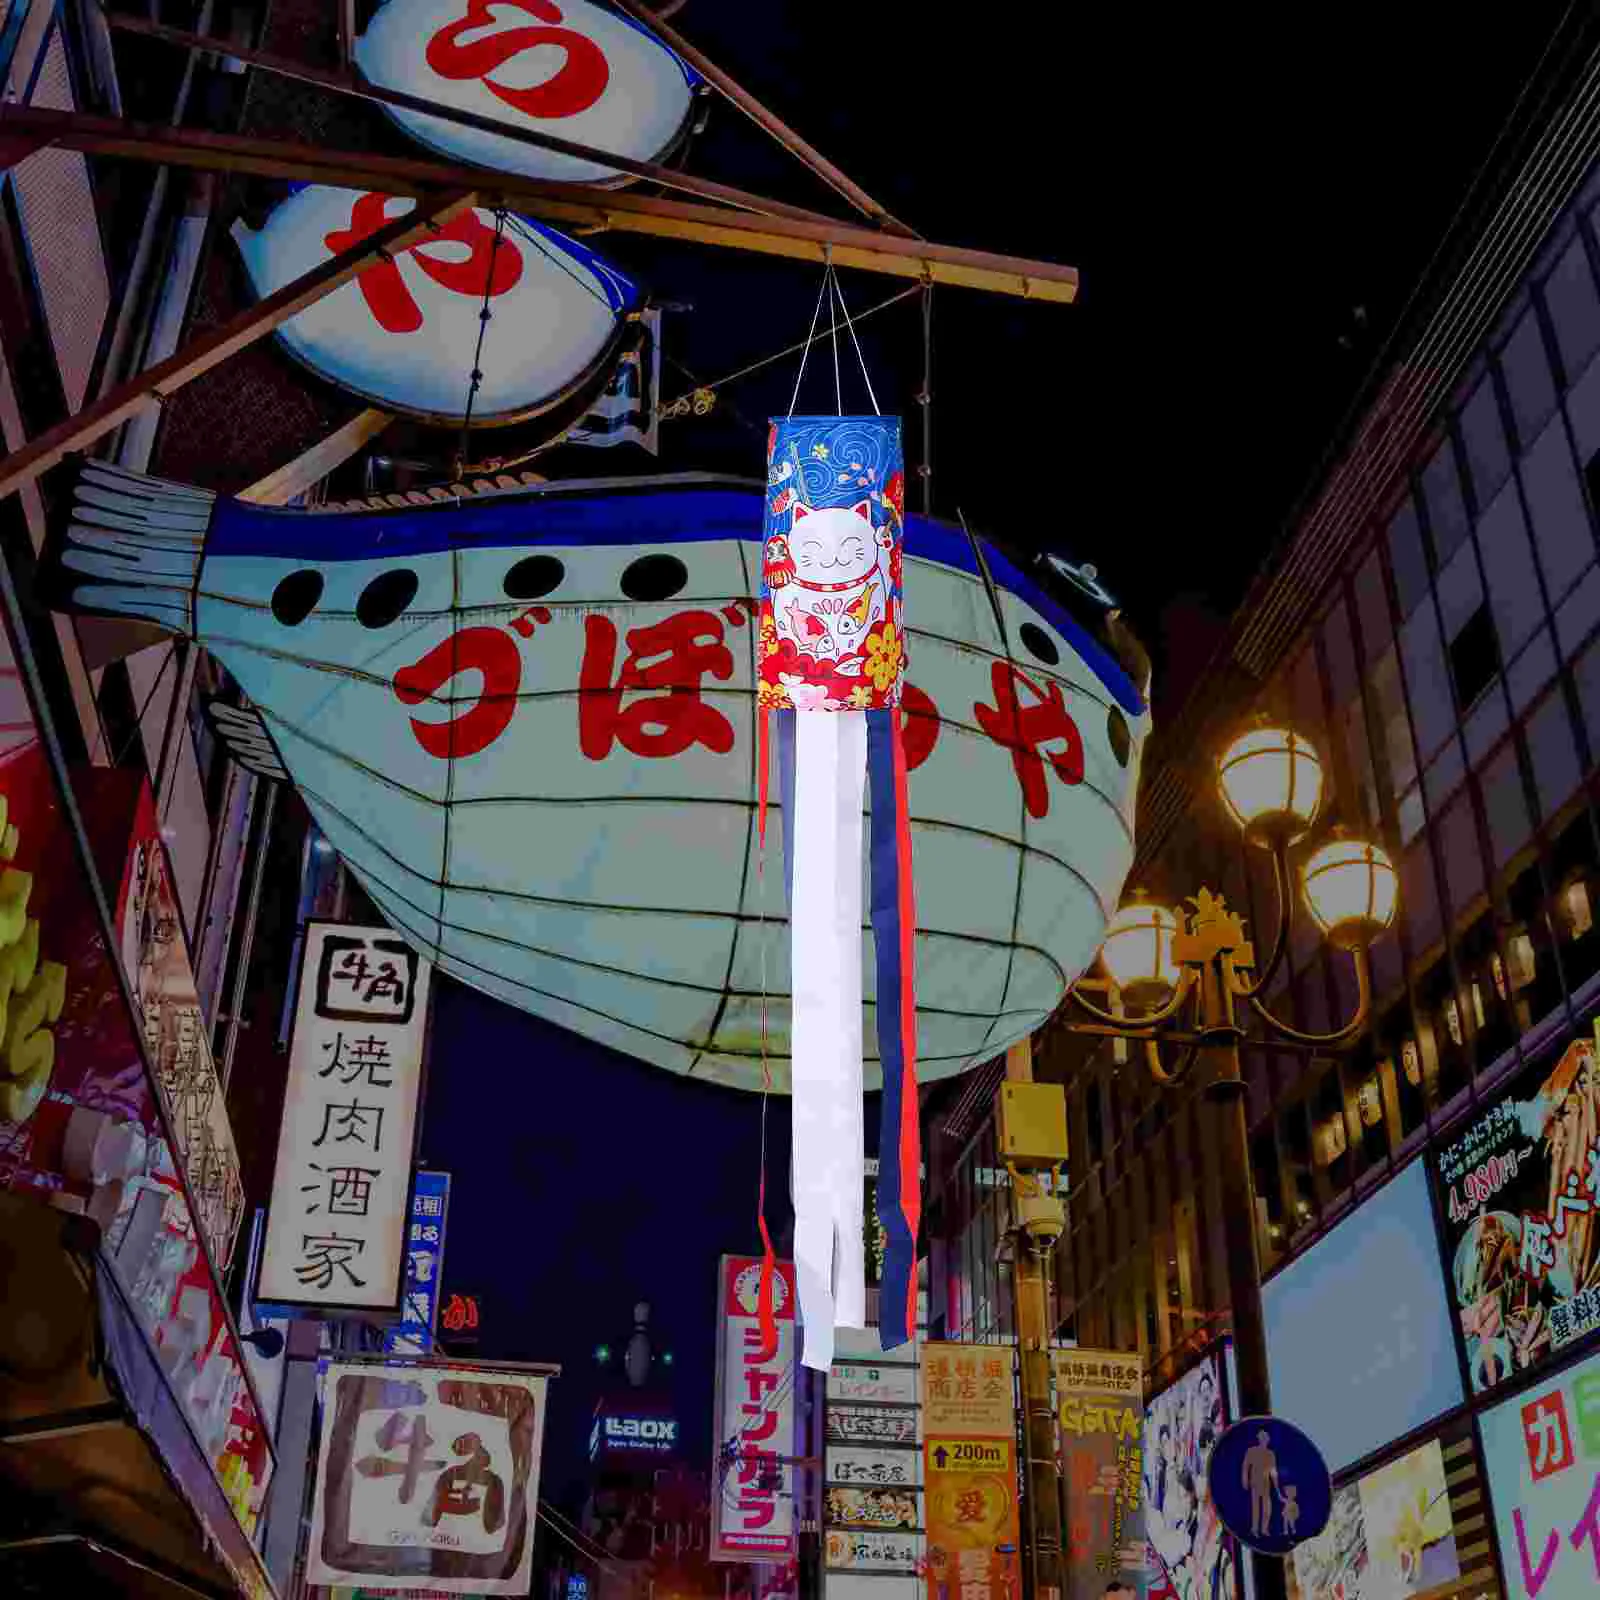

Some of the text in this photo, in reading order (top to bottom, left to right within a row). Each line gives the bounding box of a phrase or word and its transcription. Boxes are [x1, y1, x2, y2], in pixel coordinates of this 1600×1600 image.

[332, 951, 405, 1006] 牛角
[293, 1031, 393, 1290] 焼肉酒家
[354, 1412, 505, 1535] 牛角
[953, 1443, 1001, 1460] 200m
